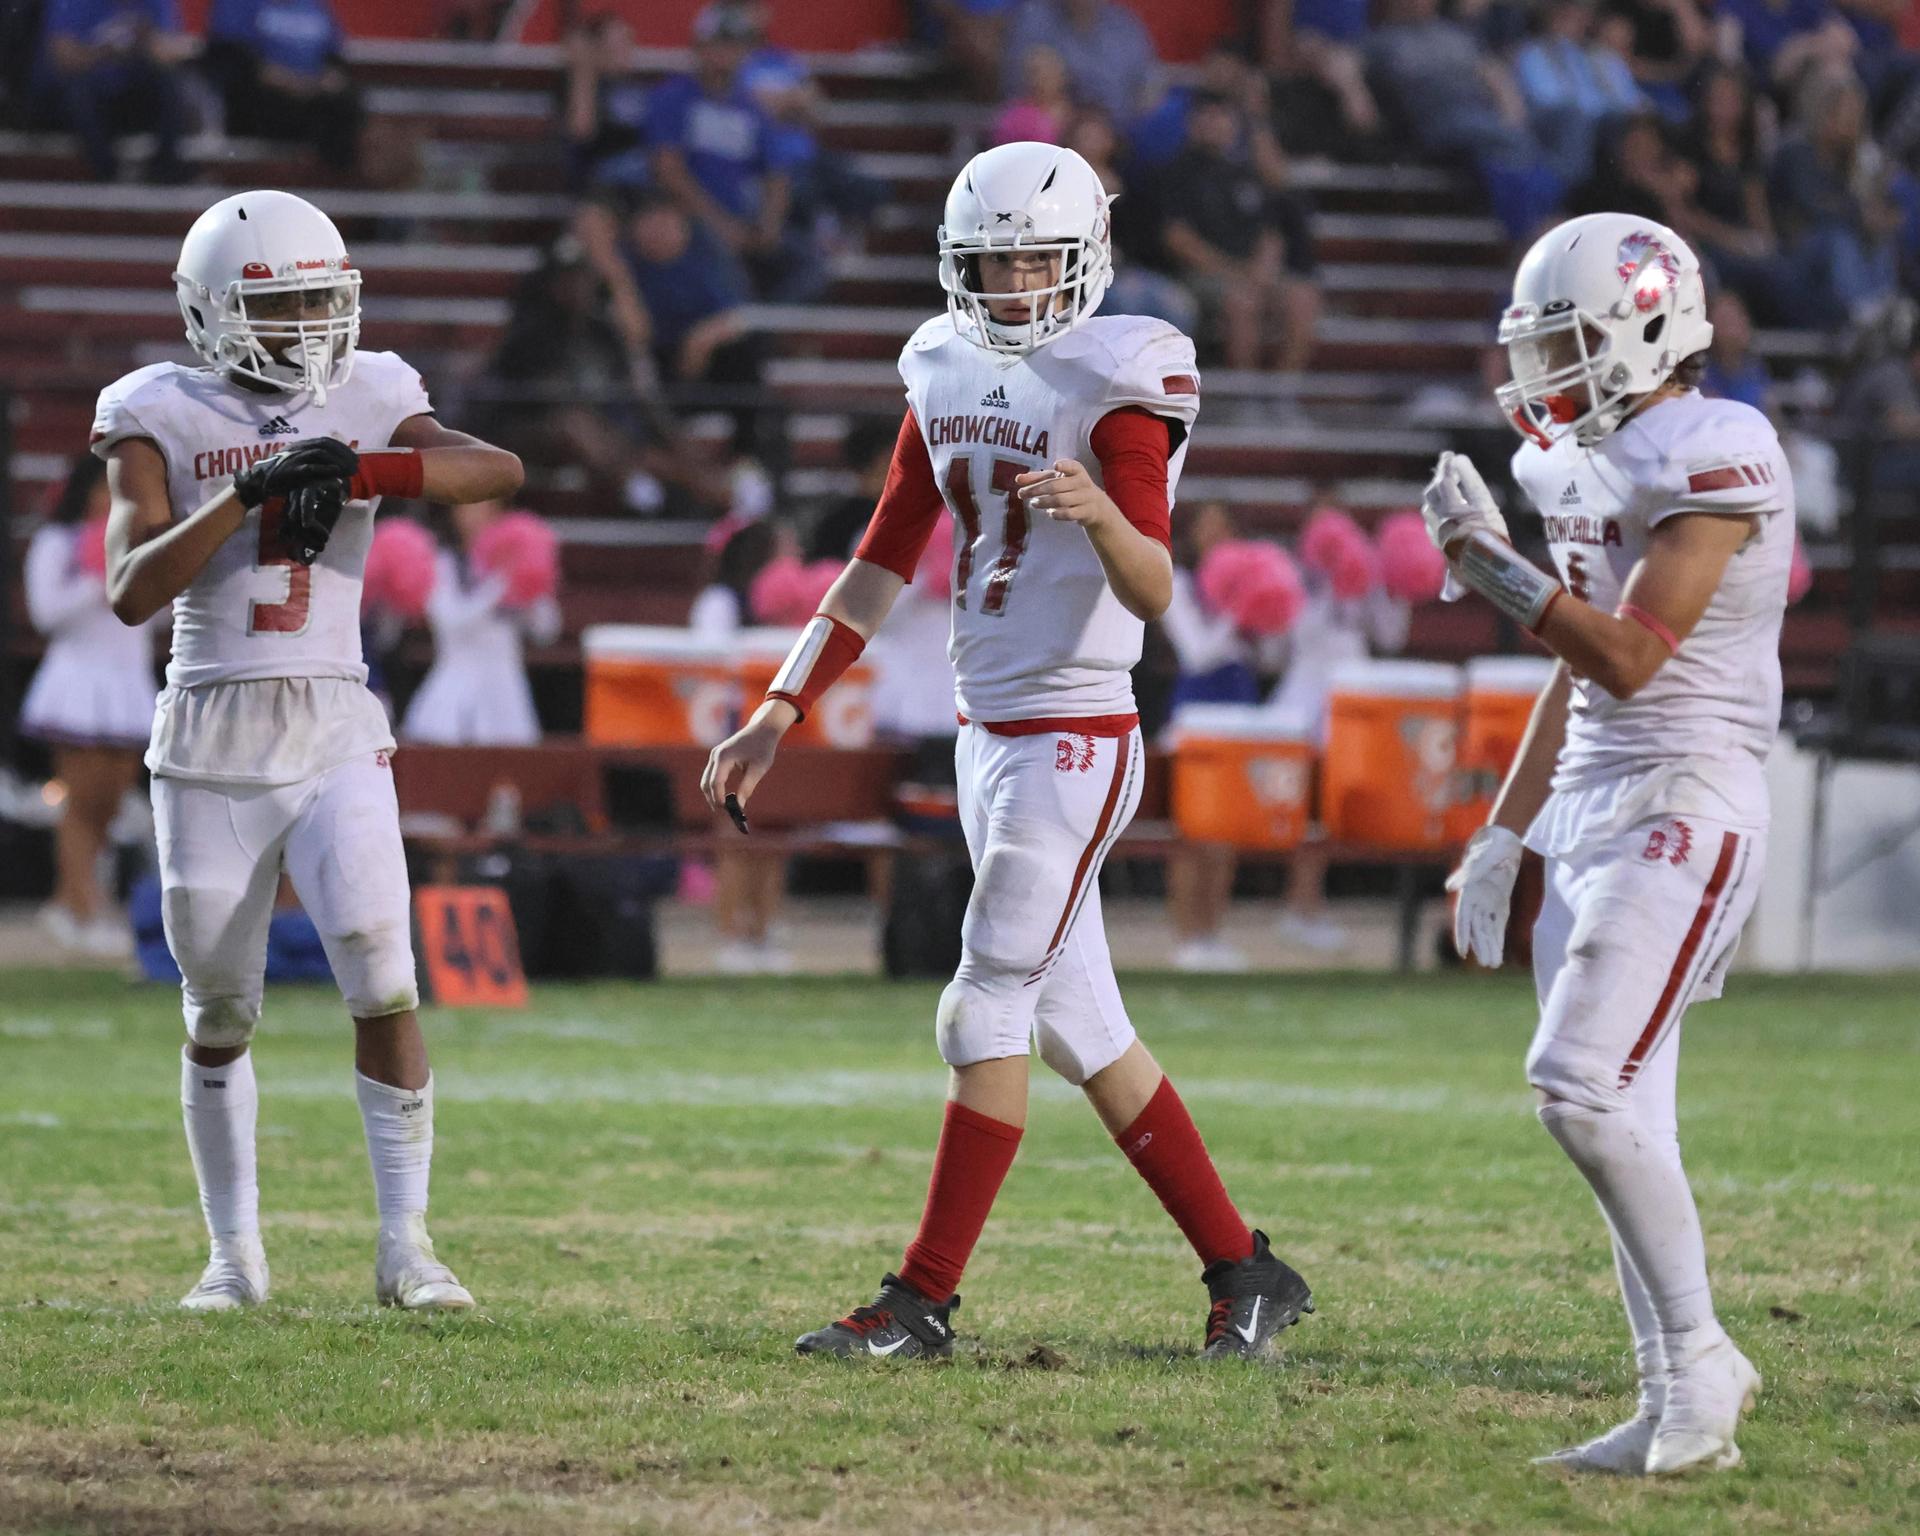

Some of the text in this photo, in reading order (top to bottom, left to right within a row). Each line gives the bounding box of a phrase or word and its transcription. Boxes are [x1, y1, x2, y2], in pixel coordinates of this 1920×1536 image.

[980, 399, 1010, 409] adidas
[257, 425, 300, 435] adidas
[930, 415, 1049, 459] CHOWCHILLA
[944, 452, 1037, 617] 17
[247, 494, 317, 637] 5
[443, 903, 521, 990] 40
[923, 1315, 946, 1337] ALPHA
